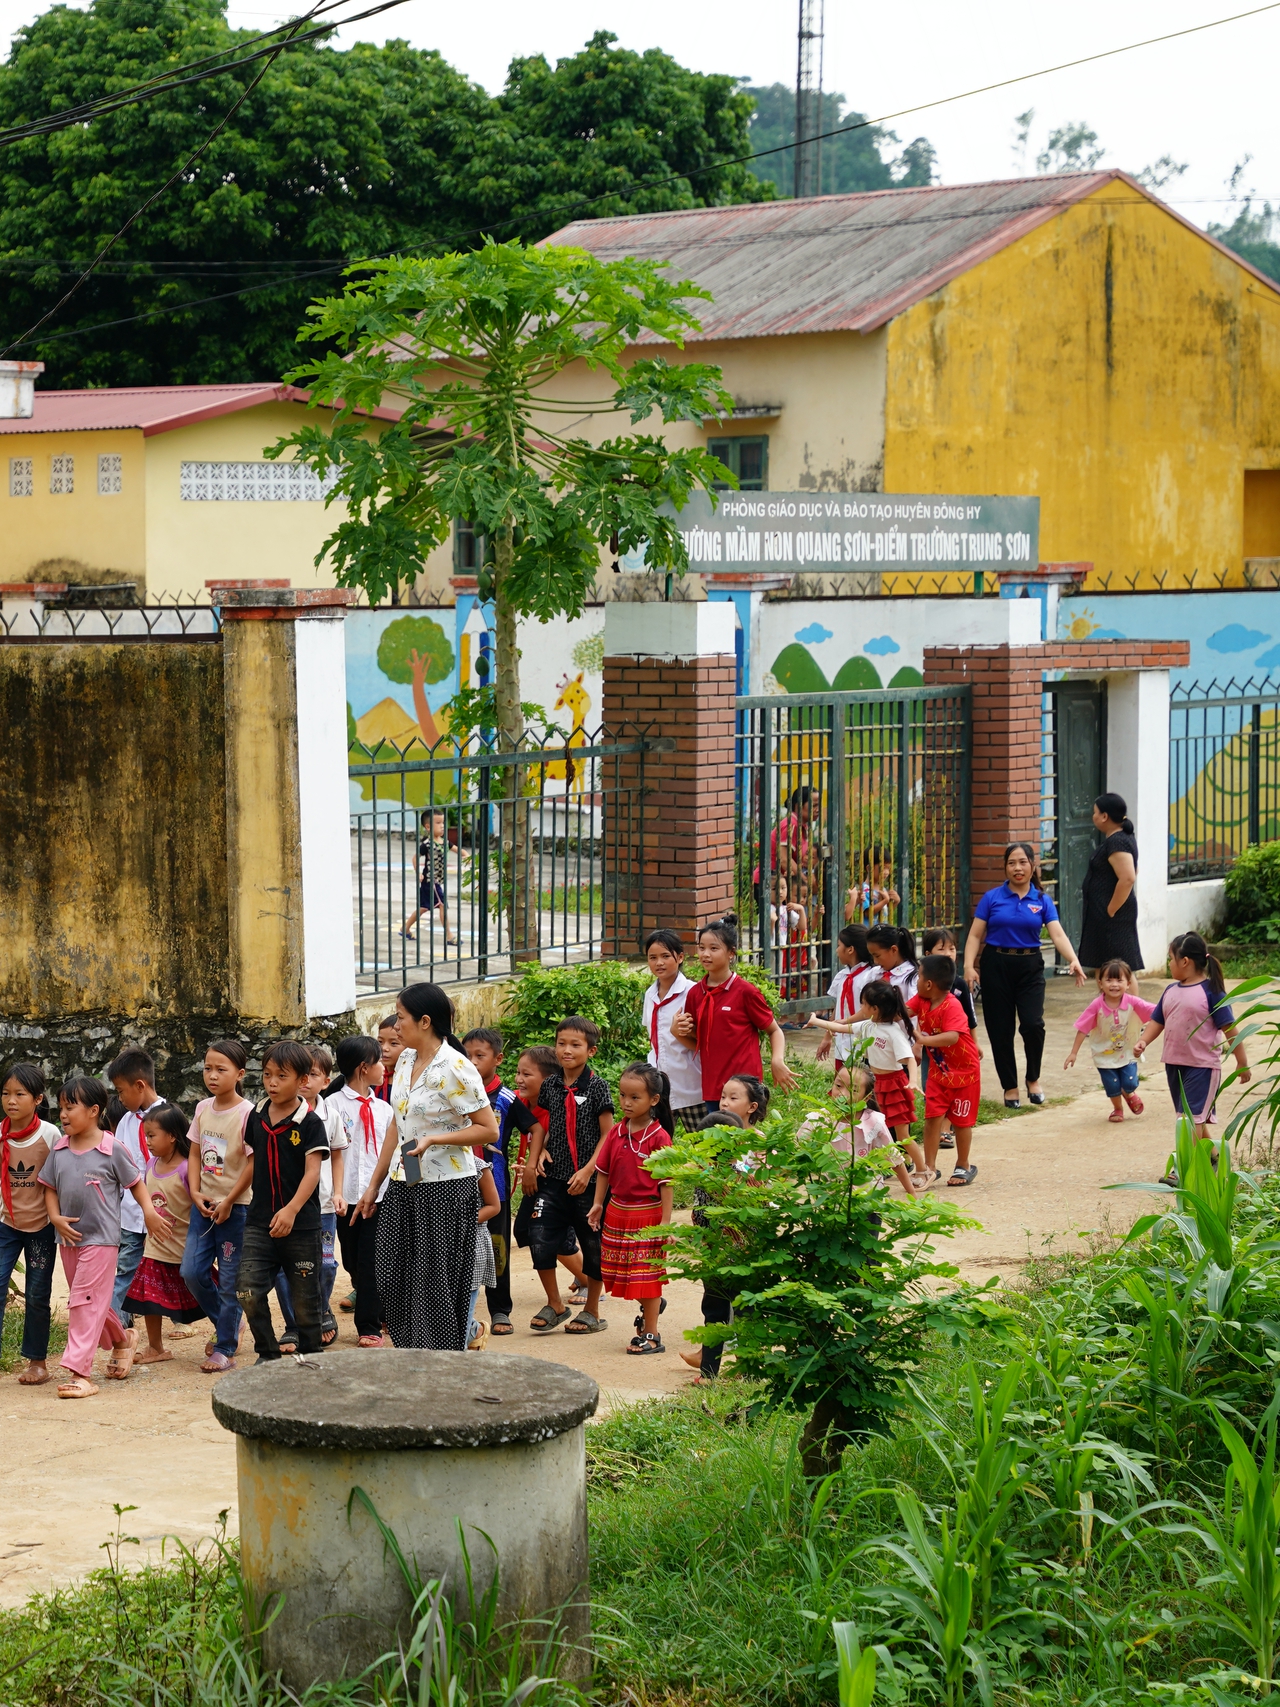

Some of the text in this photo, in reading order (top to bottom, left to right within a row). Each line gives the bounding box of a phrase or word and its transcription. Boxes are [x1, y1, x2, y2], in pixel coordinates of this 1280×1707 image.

[722, 497, 765, 517] PHÒNG
[767, 499, 796, 518] GIÁO
[799, 503, 823, 521] DỤC
[824, 501, 841, 518] VÀ
[843, 501, 868, 518] ĐÀO
[870, 504, 892, 521] TẠO
[725, 525, 761, 562] MẦM
[764, 532, 793, 562] NON
[796, 532, 841, 565] QUANG
[910, 525, 960, 562] TRƯỜNG
[961, 532, 1002, 562] TRUNG
[1005, 530, 1031, 562] SƠN
[952, 1098, 971, 1117] 10
